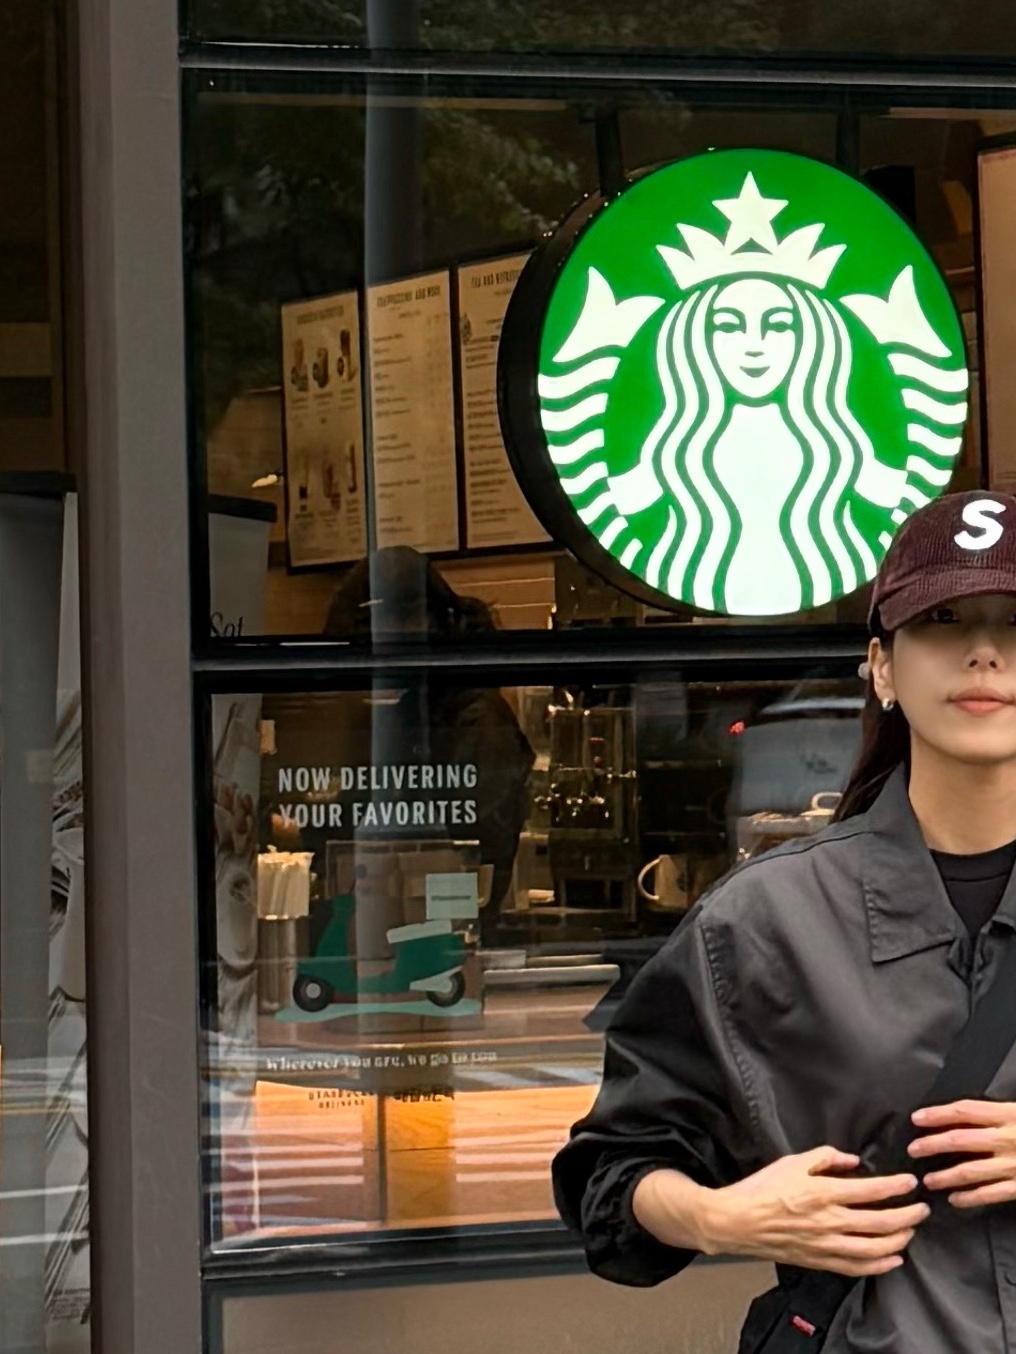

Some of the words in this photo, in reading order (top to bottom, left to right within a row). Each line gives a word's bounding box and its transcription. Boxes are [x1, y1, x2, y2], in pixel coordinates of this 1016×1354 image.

[953, 498, 1007, 551] S
[278, 767, 331, 793] NOW
[340, 764, 478, 791] DELIVERING
[279, 803, 343, 828] YOUR
[353, 799, 478, 827] FAVORITES
